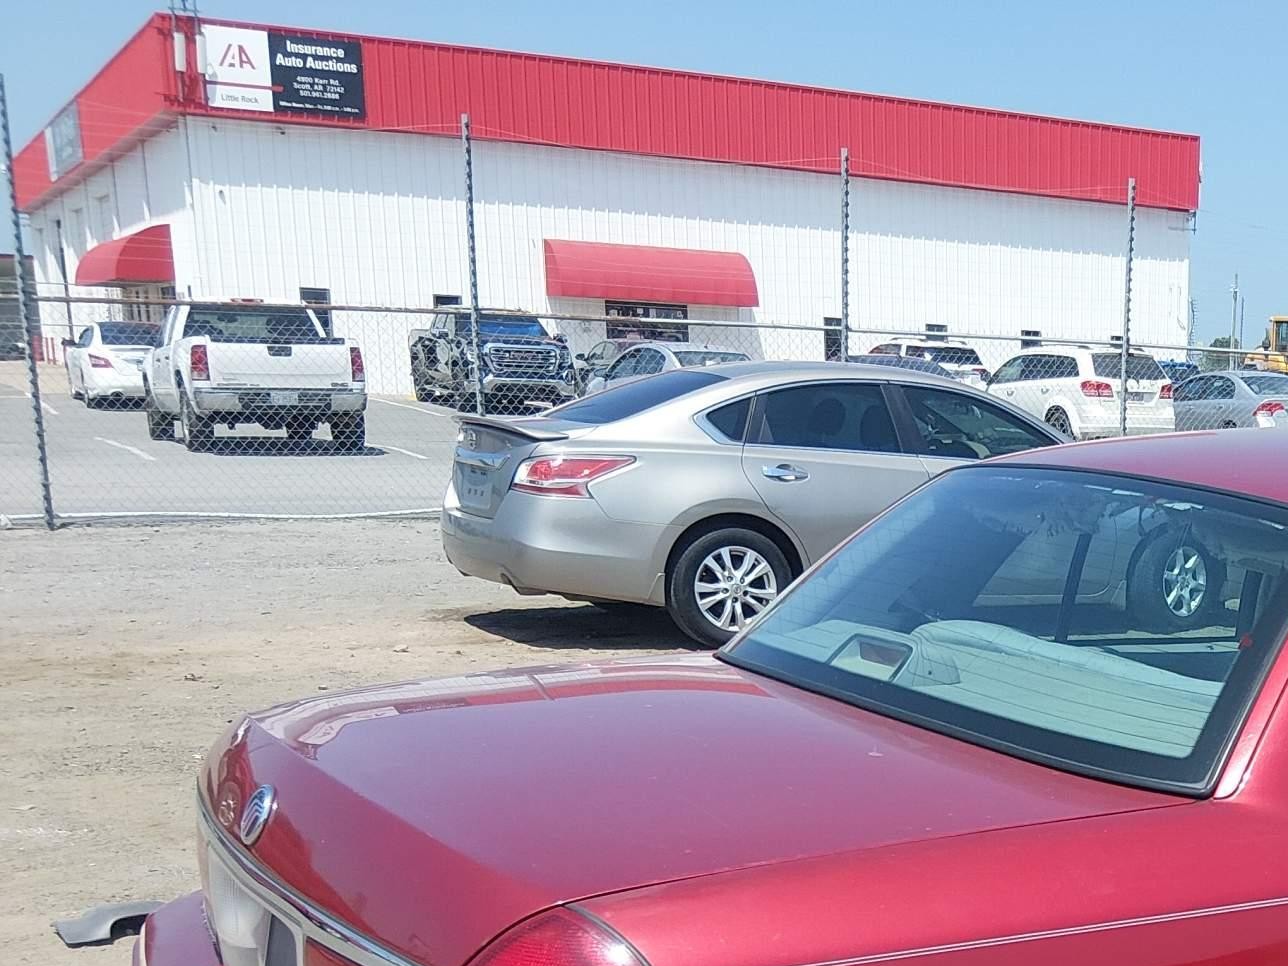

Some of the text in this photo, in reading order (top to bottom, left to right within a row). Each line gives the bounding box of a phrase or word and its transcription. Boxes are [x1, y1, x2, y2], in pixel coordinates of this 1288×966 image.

[286, 40, 345, 58] Insurance
[276, 53, 358, 74] Auto Auctions
[221, 93, 260, 105] Little Rock
